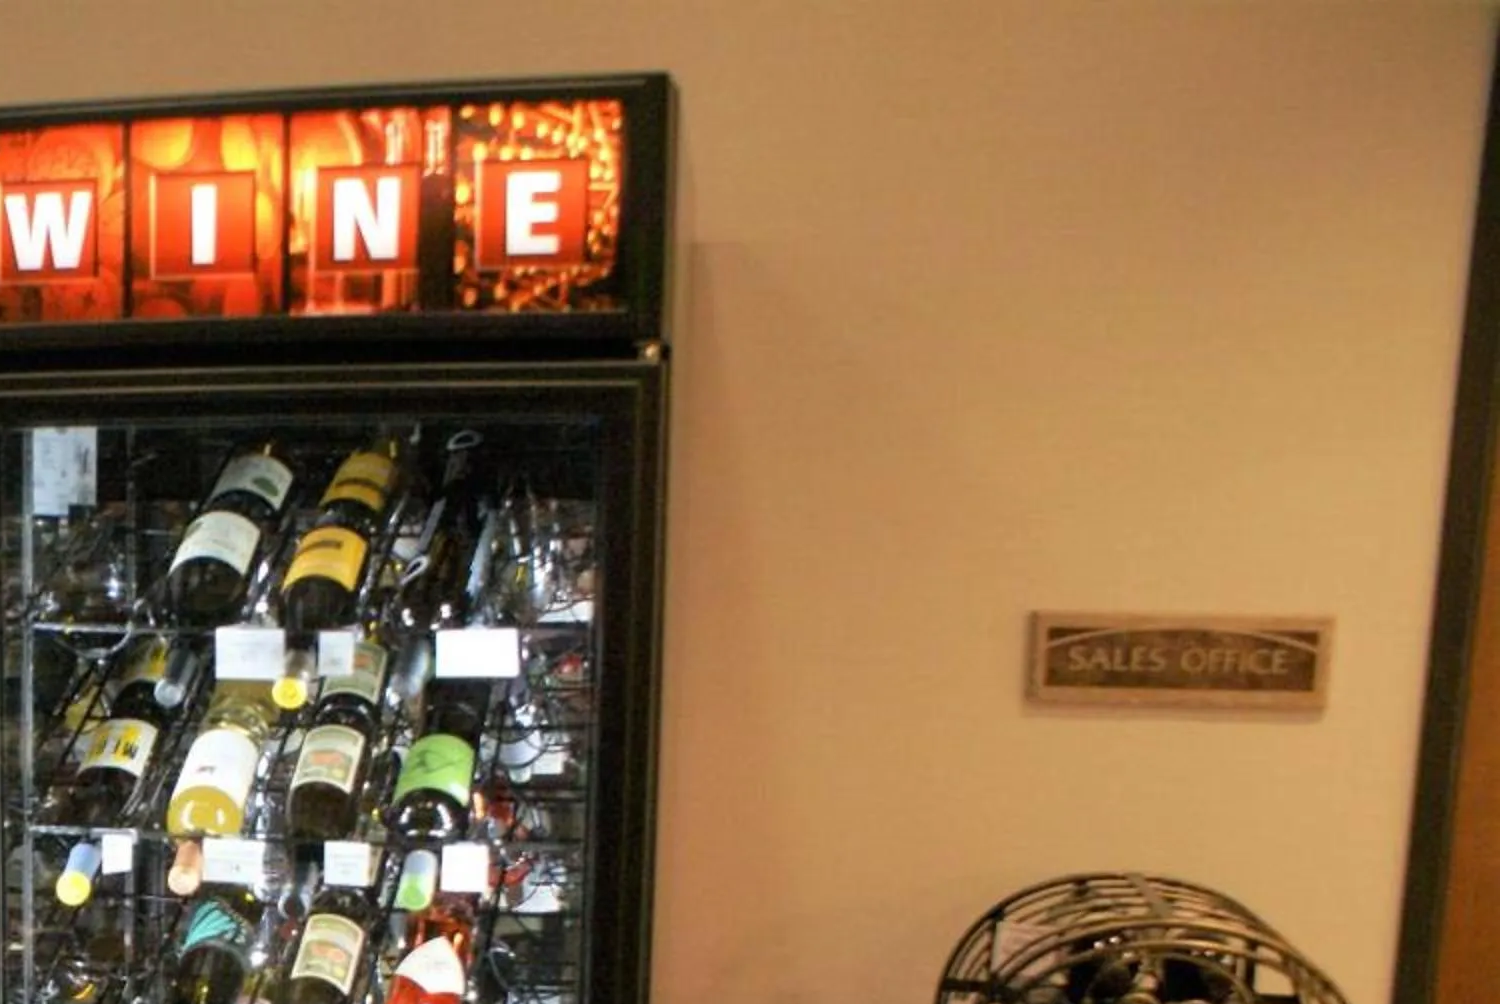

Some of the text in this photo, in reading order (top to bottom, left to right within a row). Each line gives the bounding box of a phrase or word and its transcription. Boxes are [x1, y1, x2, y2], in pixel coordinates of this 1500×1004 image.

[5, 170, 562, 272] WINE
[1067, 645, 1290, 675] SALES OFFICE
